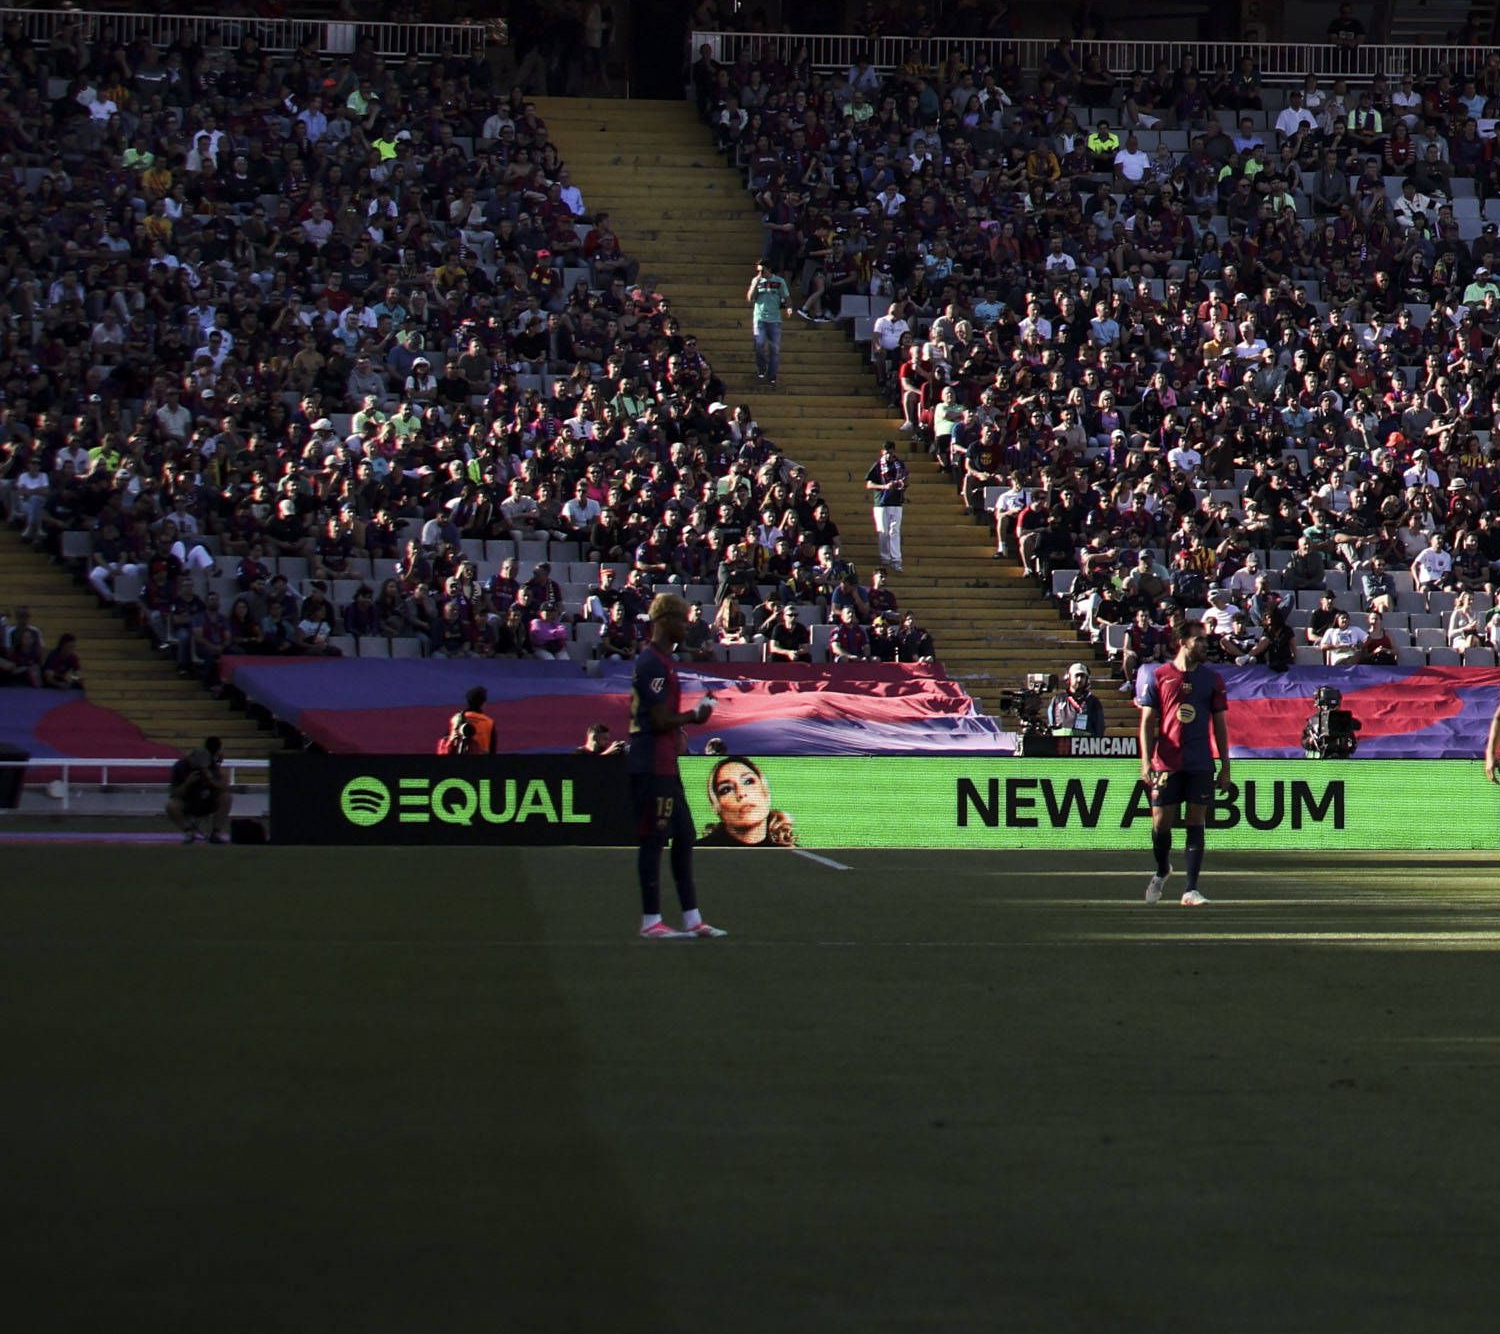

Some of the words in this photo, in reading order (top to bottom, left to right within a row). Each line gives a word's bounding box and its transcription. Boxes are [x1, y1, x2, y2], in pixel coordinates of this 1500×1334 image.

[400, 778, 591, 826] EQUAL
[656, 797, 673, 817] 19
[957, 778, 1109, 827] NEW
[1120, 779, 1344, 830] ABUM
